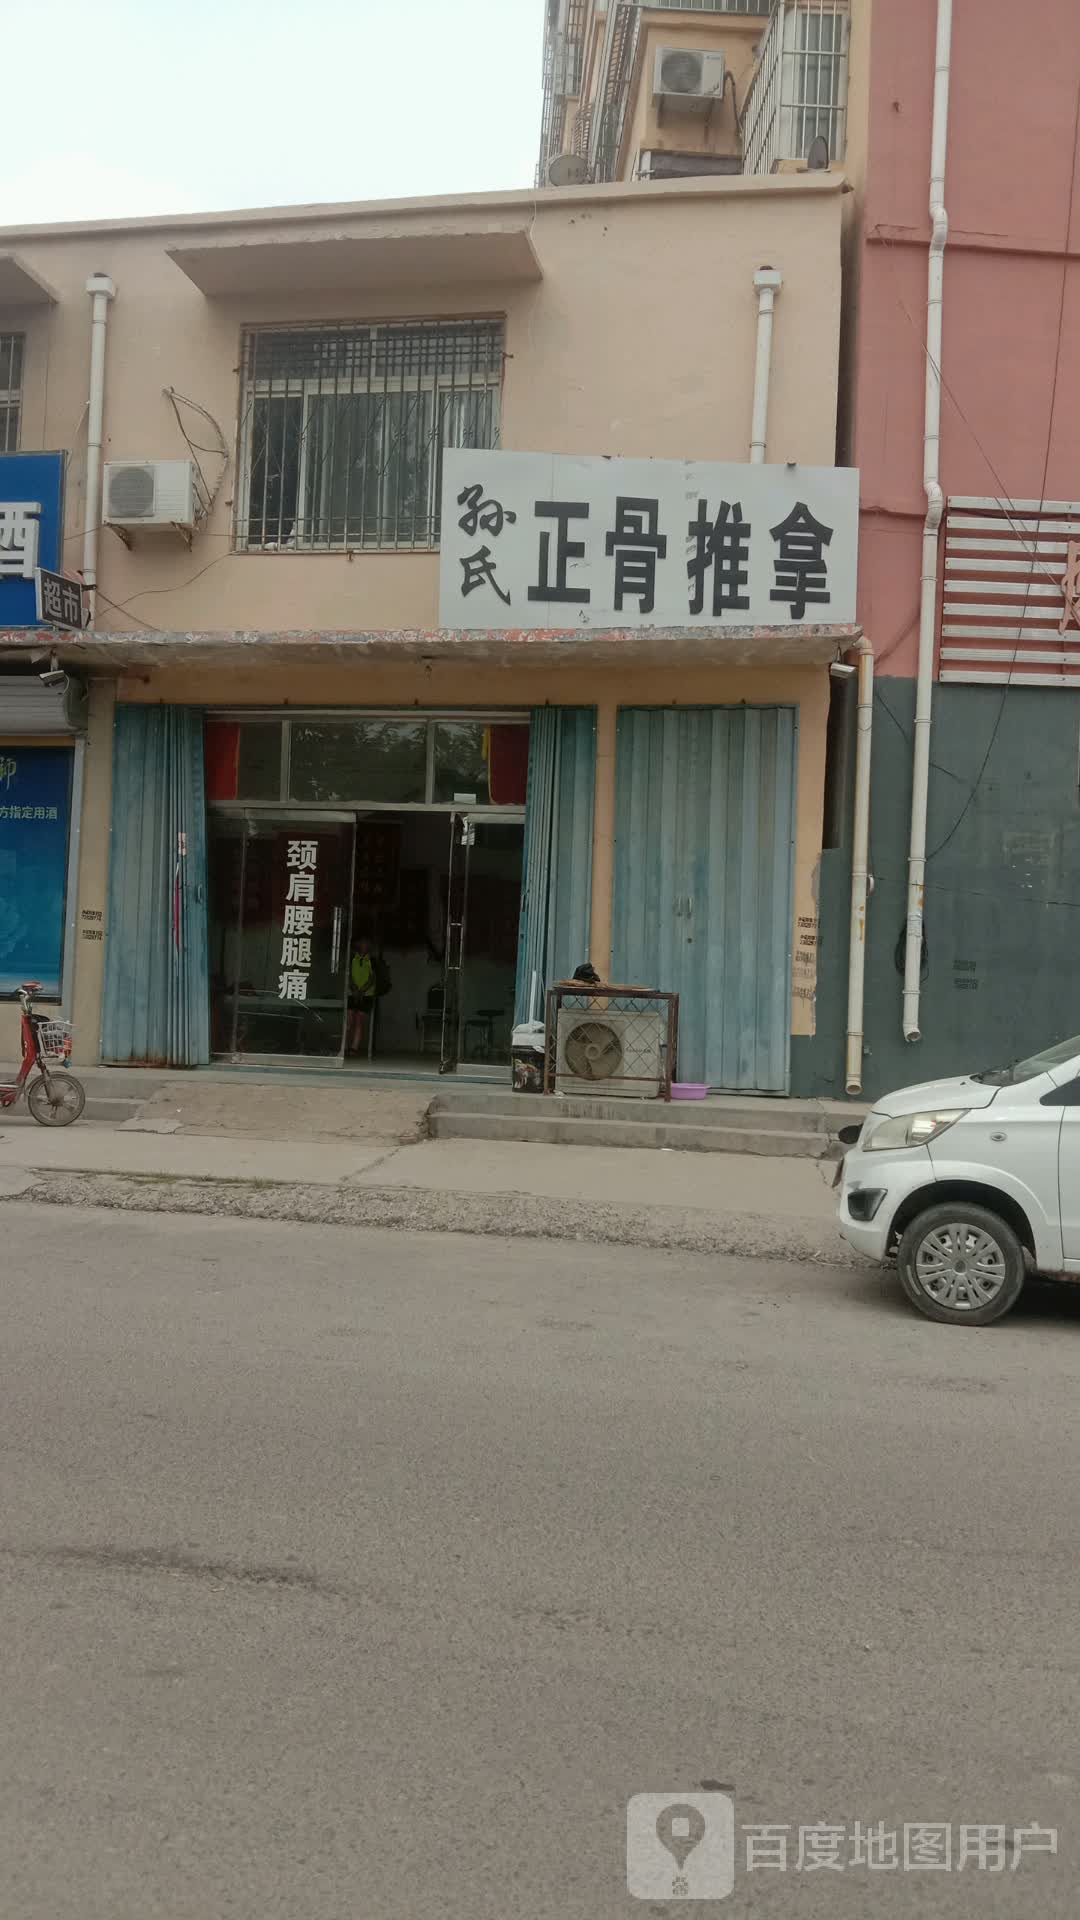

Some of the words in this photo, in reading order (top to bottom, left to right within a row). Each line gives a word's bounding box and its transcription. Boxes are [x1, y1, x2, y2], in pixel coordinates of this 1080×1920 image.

[44, 578, 80, 623] 超市
[457, 484, 517, 606] 孙氏
[527, 496, 834, 620] 正骨推拿
[278, 840, 319, 1001] 颈肩腰腿痛
